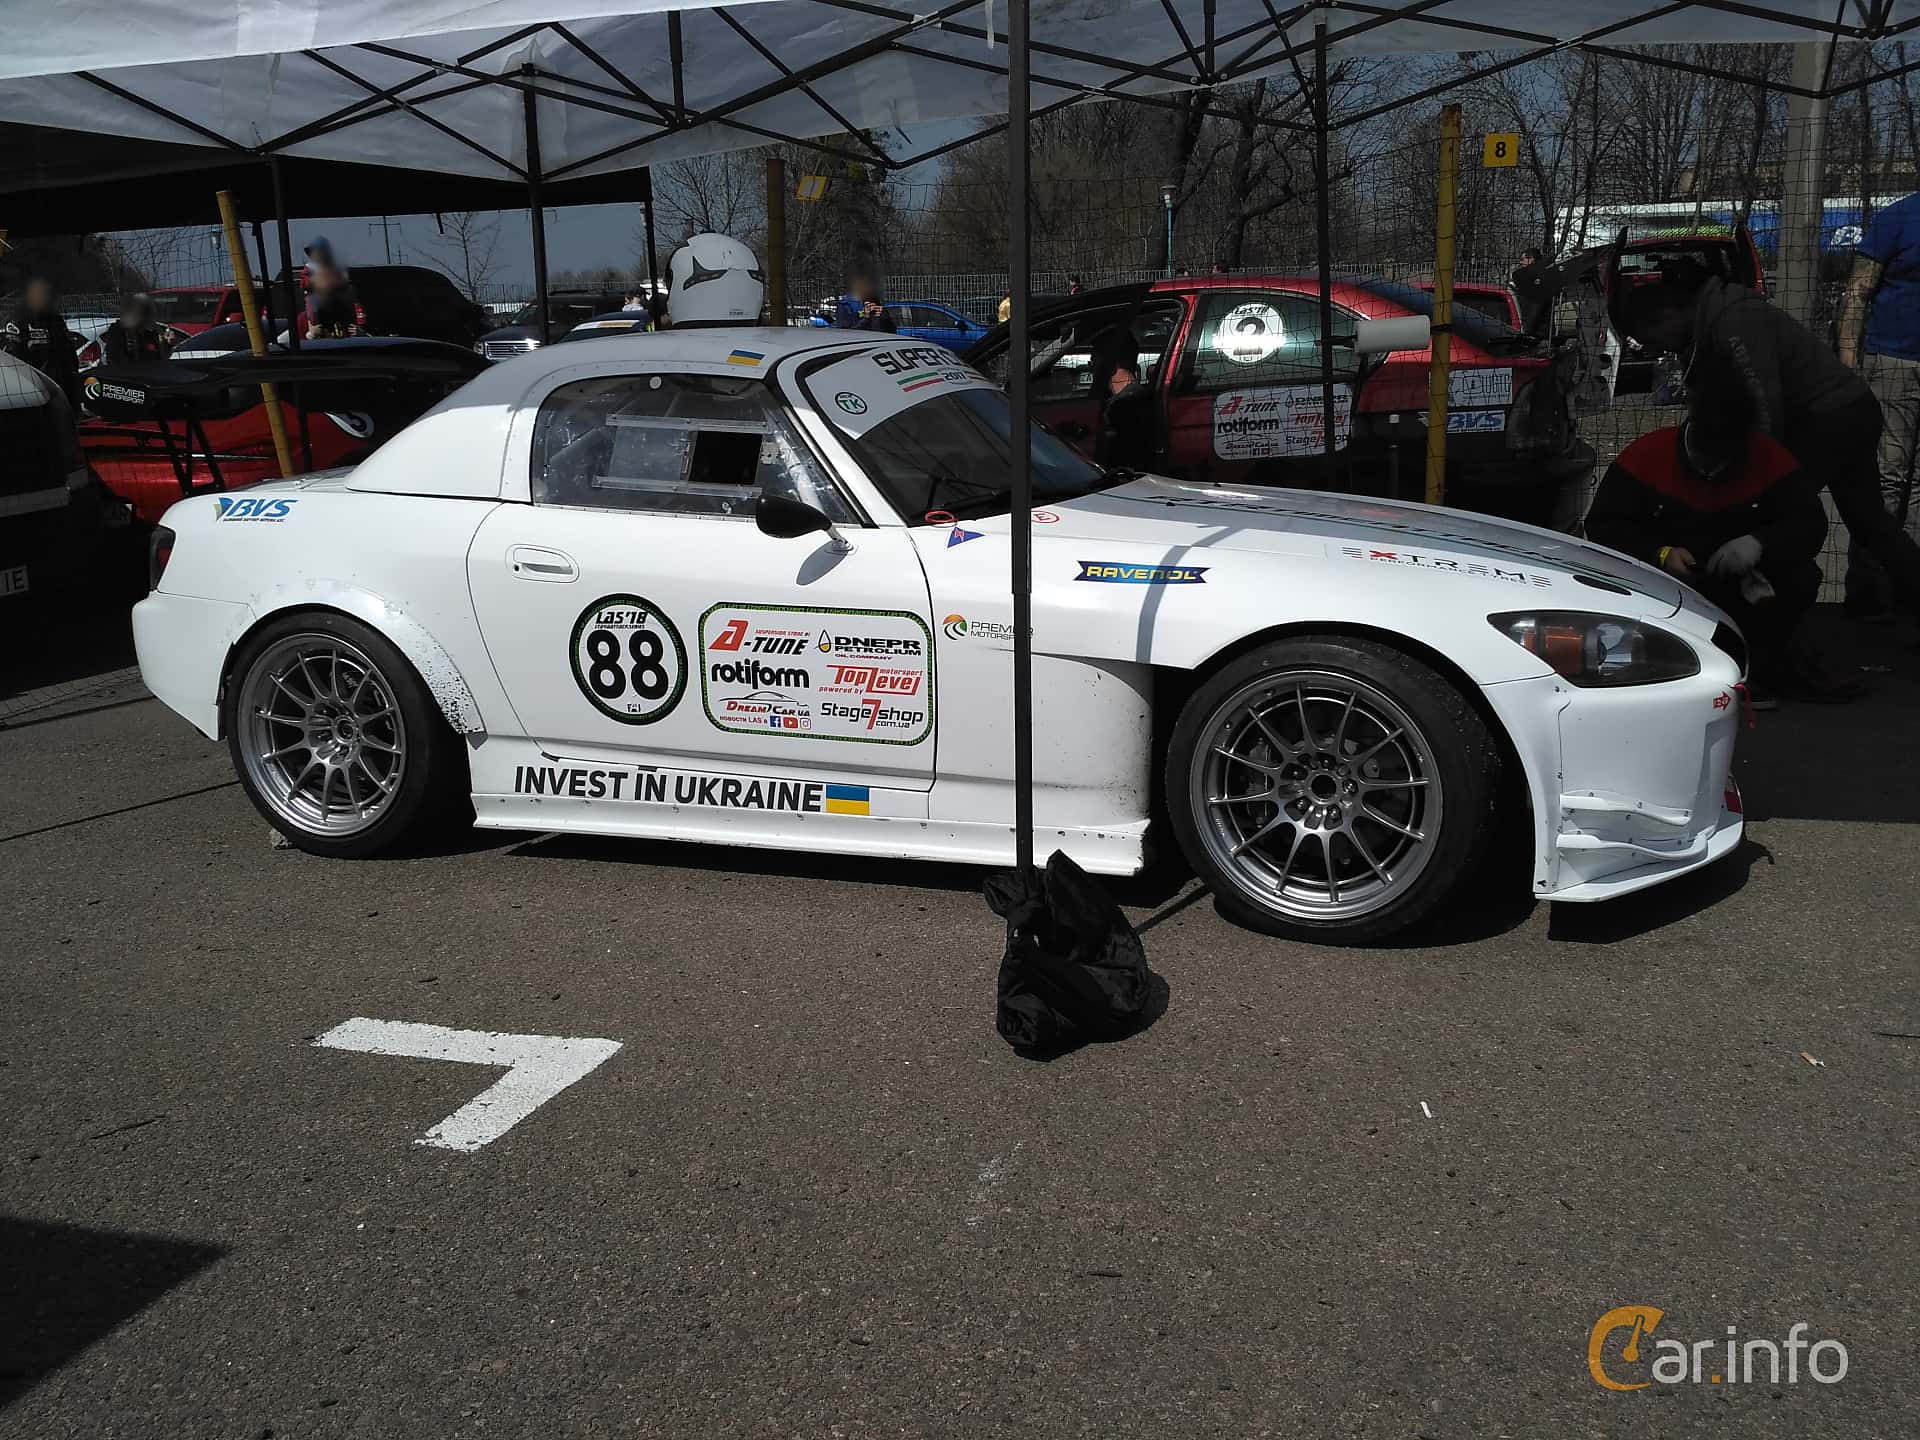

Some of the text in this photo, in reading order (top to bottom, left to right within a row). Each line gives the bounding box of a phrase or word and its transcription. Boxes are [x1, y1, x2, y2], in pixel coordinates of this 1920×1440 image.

[1494, 141, 1506, 158] 8
[102, 391, 144, 404] MOTORSPORT
[103, 383, 145, 400] PREMIER
[1217, 417, 1280, 435] rotiform
[226, 498, 299, 518] BVS
[1086, 566, 1197, 580] RAVENOL
[595, 611, 648, 625] LAS'18
[708, 620, 809, 655] A-TUNE
[834, 636, 921, 650] DNEPR
[834, 645, 922, 656] PETROLIUM
[586, 629, 669, 700] 88
[711, 659, 810, 690] rotiform
[879, 668, 923, 676] motorsport
[818, 686, 853, 694] powered
[748, 716, 762, 724] LAS
[875, 720, 910, 729] com.ua
[514, 766, 824, 813] INVEST IN UKRAINE
